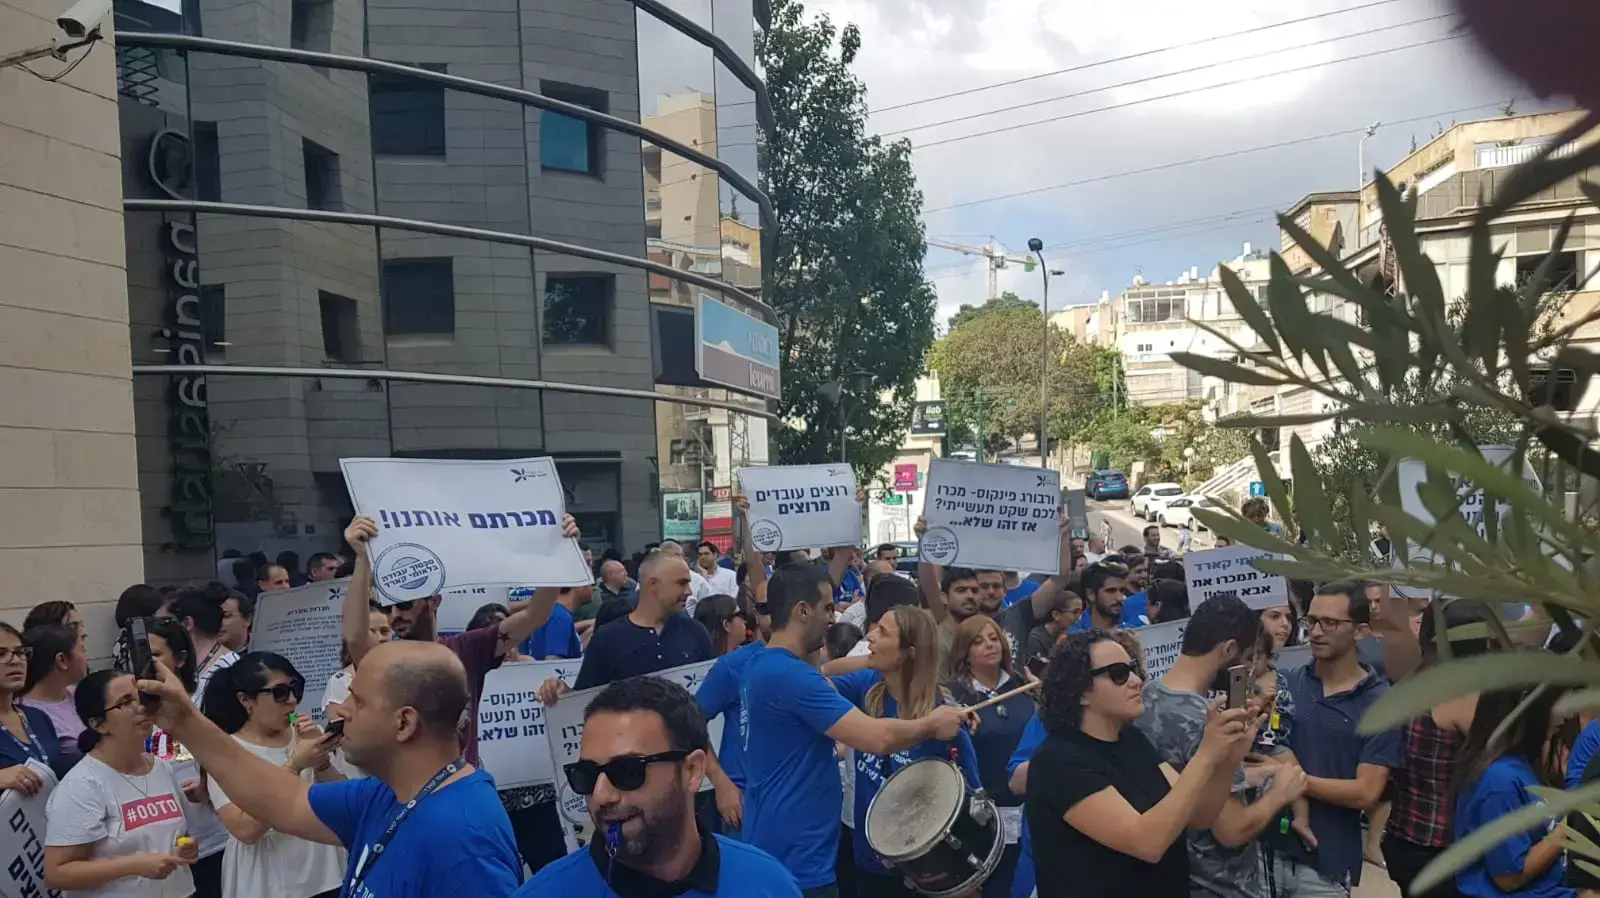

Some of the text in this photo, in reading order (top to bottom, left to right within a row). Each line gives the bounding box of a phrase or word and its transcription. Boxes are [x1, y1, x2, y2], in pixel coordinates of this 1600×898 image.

[755, 484, 848, 502] רוצים עובדים
[937, 483, 1055, 505] ורבורג פינקוס- מכרו
[778, 500, 831, 515] מרוצים
[935, 498, 1056, 520] לכם שקט תעשייתי?
[379, 508, 557, 530] מכרתם אותנו!
[949, 515, 1038, 532] אז זהו שלא...
[381, 558, 435, 583] סכסוך עבודה
[1194, 559, 1231, 571] קארד
[384, 565, 439, 589] בלאומי קארד
[1192, 577, 1213, 588] את
[1216, 571, 1257, 584] תמכרו
[1241, 584, 1271, 596] אבא
[482, 691, 537, 707] פינקוס-
[522, 723, 545, 737] זהו
[126, 799, 178, 823] #OOTD
